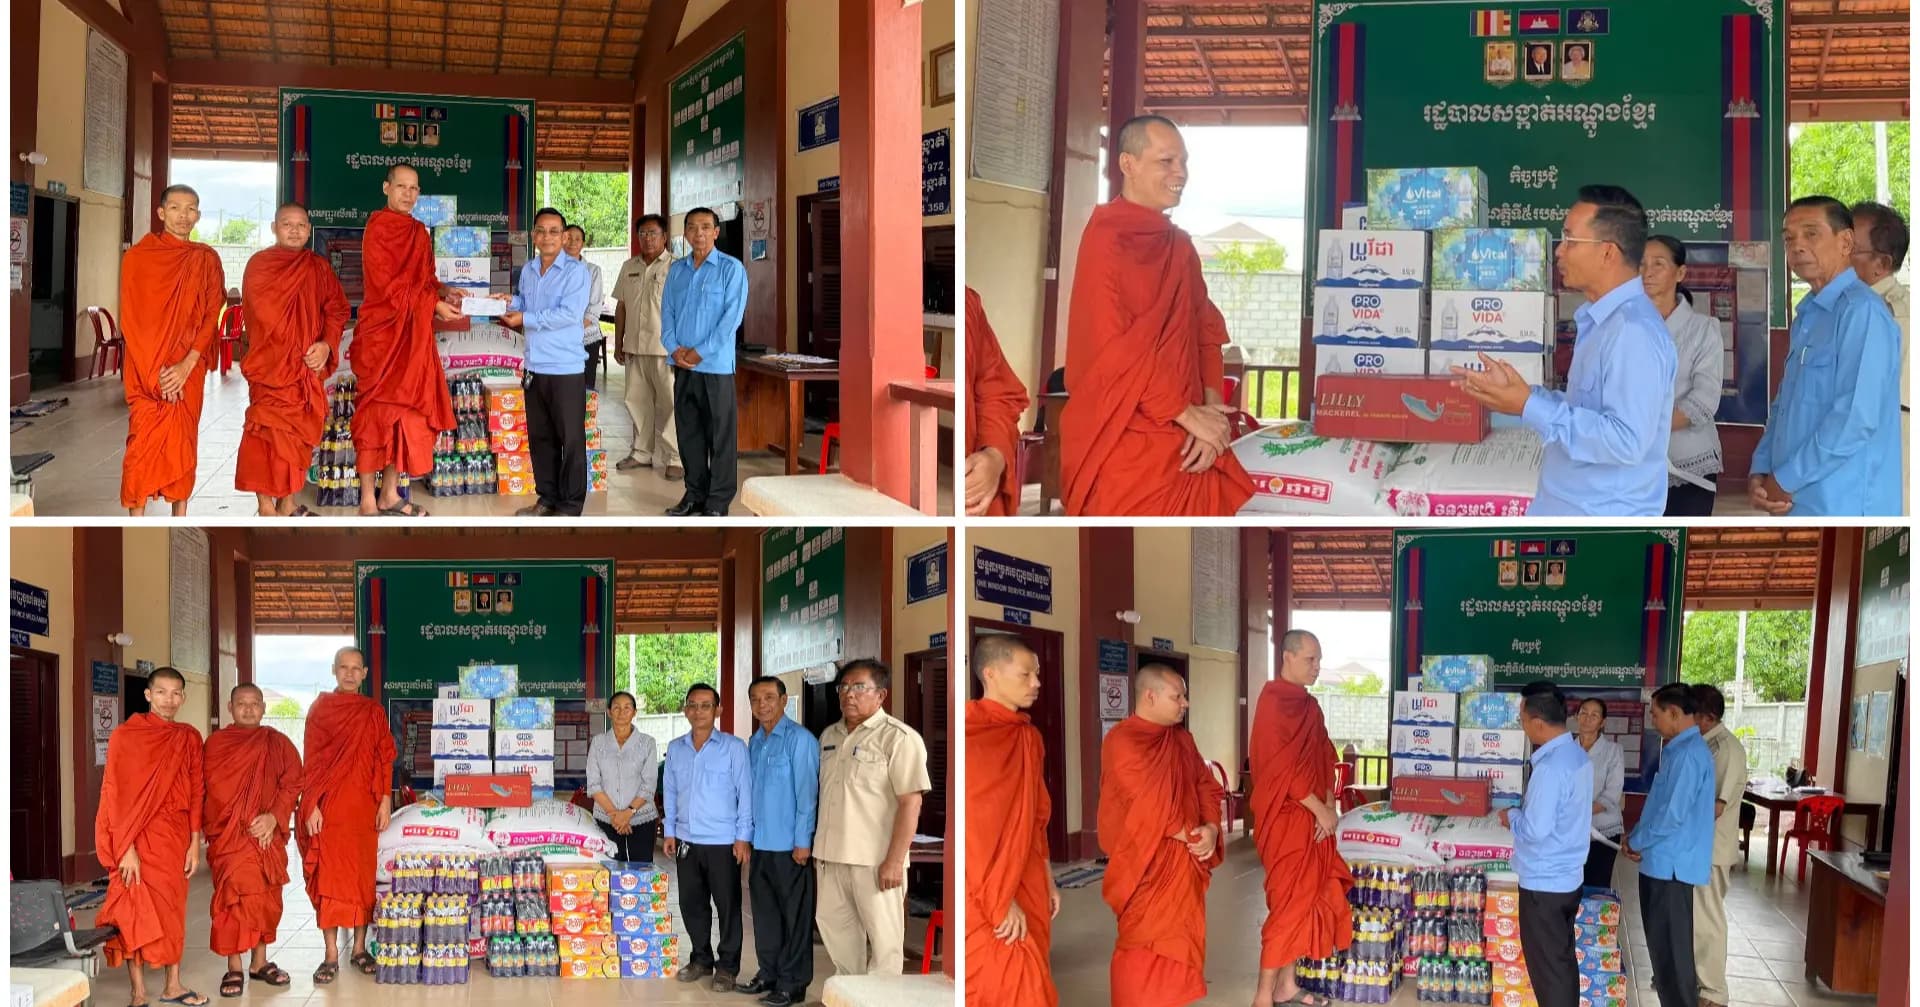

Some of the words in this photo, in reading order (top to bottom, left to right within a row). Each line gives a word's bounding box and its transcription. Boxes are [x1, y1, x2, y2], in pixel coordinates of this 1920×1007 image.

[928, 161, 944, 172] 972
[1414, 187, 1441, 199] Vital
[928, 202, 944, 212] 358
[1480, 247, 1507, 260] Vital
[1353, 295, 1380, 307] PRO
[1473, 299, 1502, 311] PRO
[1356, 355, 1384, 367] PRO
[1319, 392, 1365, 408] LILLY
[1316, 409, 1361, 418] MACKEREL
[1413, 729, 1430, 737] PRO
